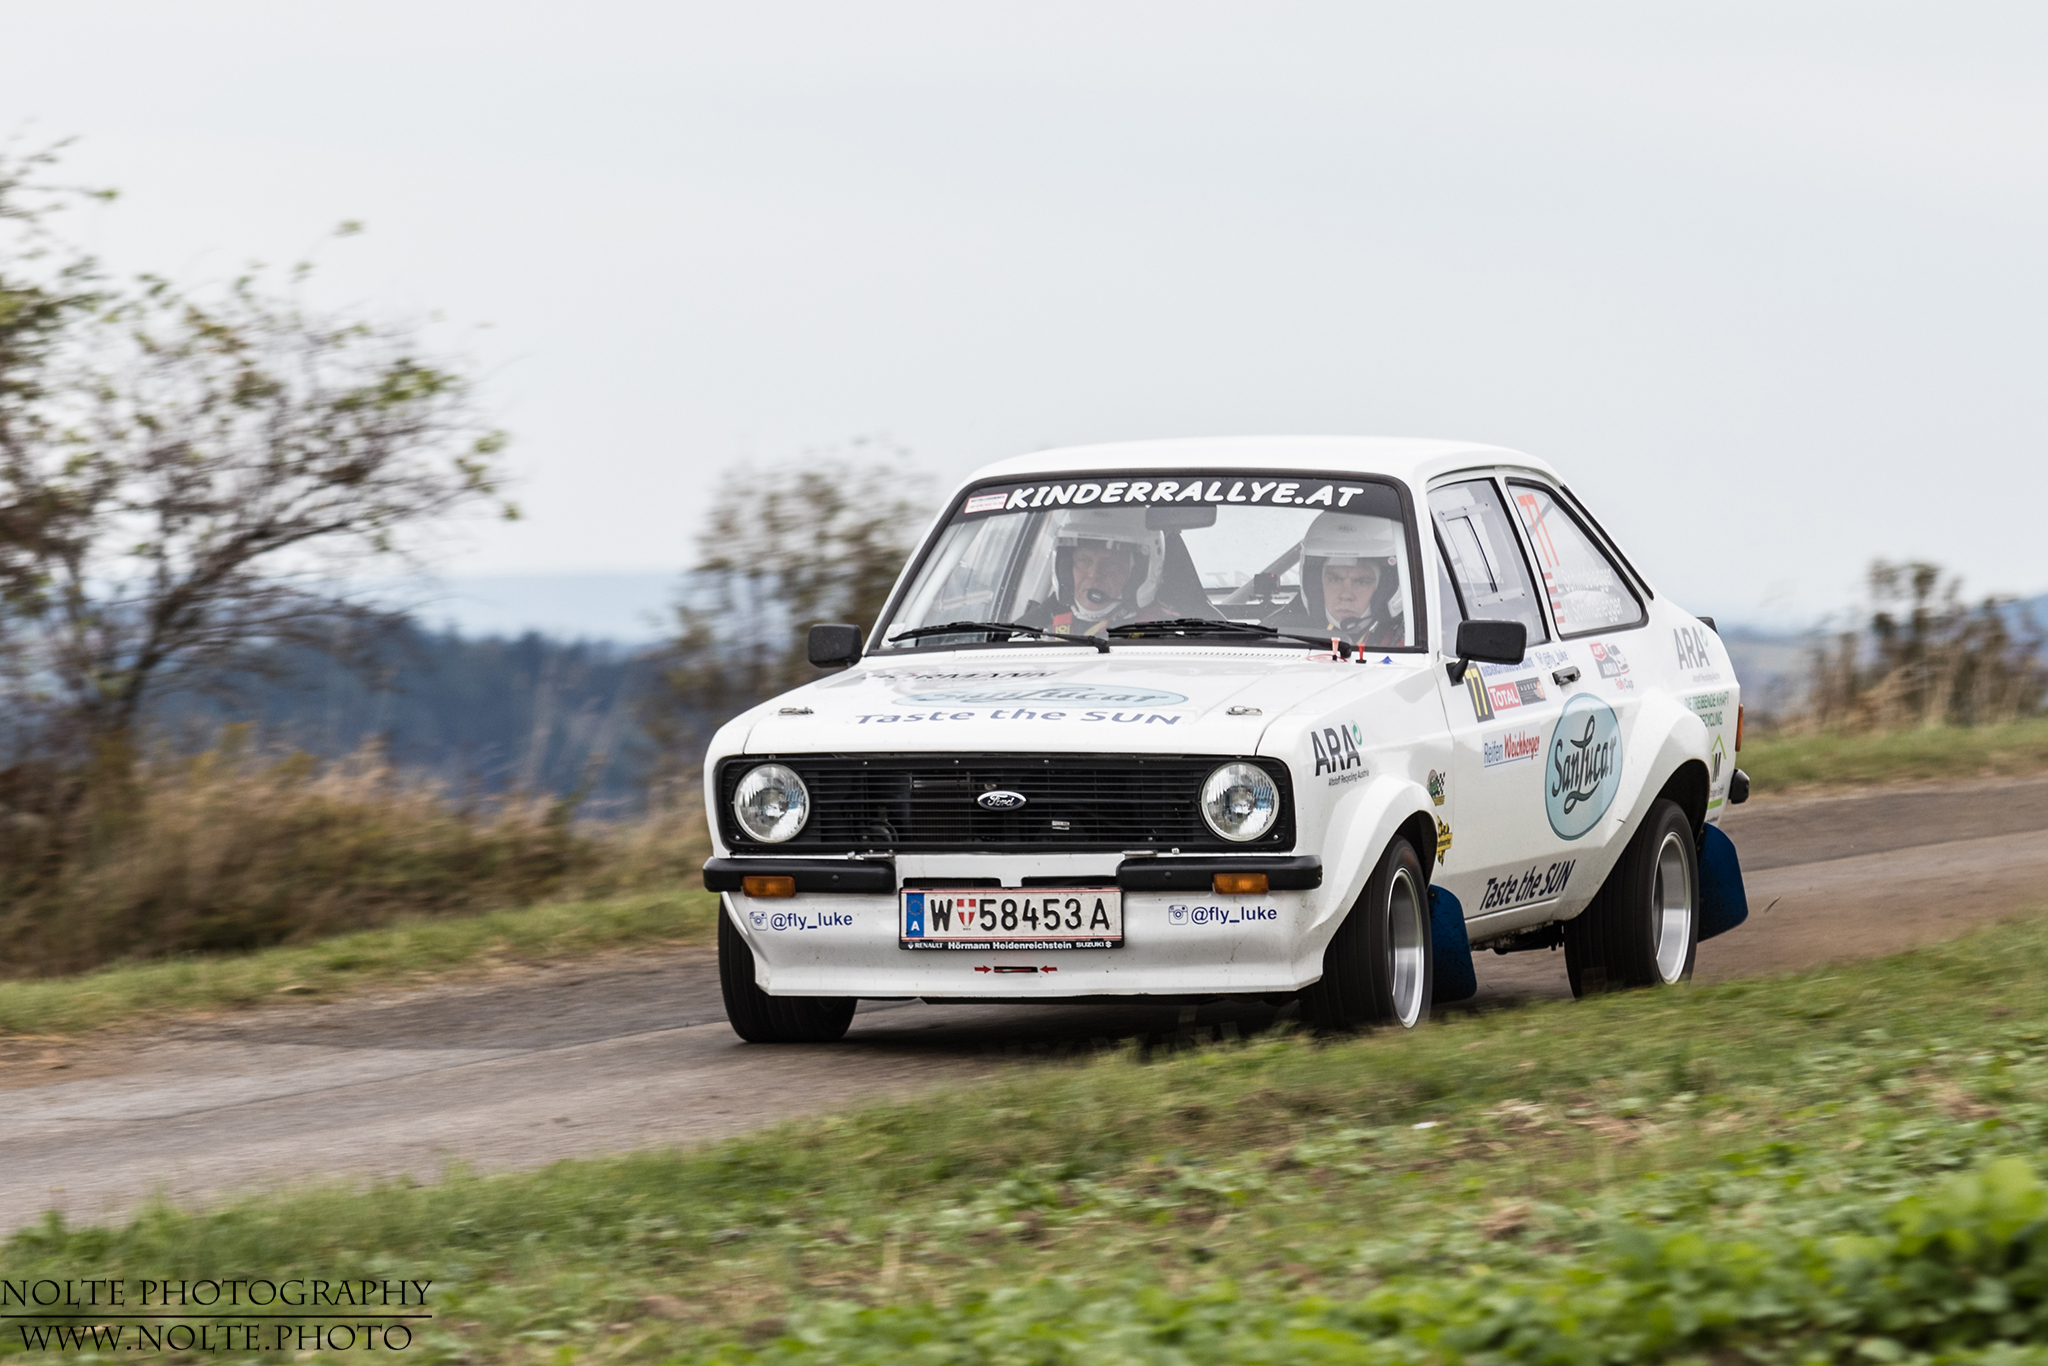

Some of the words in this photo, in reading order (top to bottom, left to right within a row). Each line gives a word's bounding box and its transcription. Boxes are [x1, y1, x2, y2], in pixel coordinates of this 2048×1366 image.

[1005, 481, 1364, 509] KINDERRALLYE.AT
[1517, 493, 1560, 568] 77
[1673, 626, 1711, 670] ARA
[1464, 667, 1489, 717] 77
[1490, 687, 1519, 708] TOTAL
[855, 710, 976, 725] Taste
[989, 708, 1067, 721] the
[1080, 711, 1182, 725] SUN
[1310, 724, 1362, 777] ARA
[1484, 740, 1504, 764] Reifen
[1551, 714, 1617, 815] SanLucar
[987, 793, 1015, 807] Ford
[1479, 873, 1519, 911] Taste
[1514, 865, 1543, 902] the
[1538, 859, 1577, 896] SUN
[770, 911, 853, 931] @fly_luke
[910, 921, 920, 931] A
[1190, 905, 1278, 925] @fly_luke
[947, 941, 991, 950] Hörmann
[992, 941, 1072, 950] Heidenreichstein
